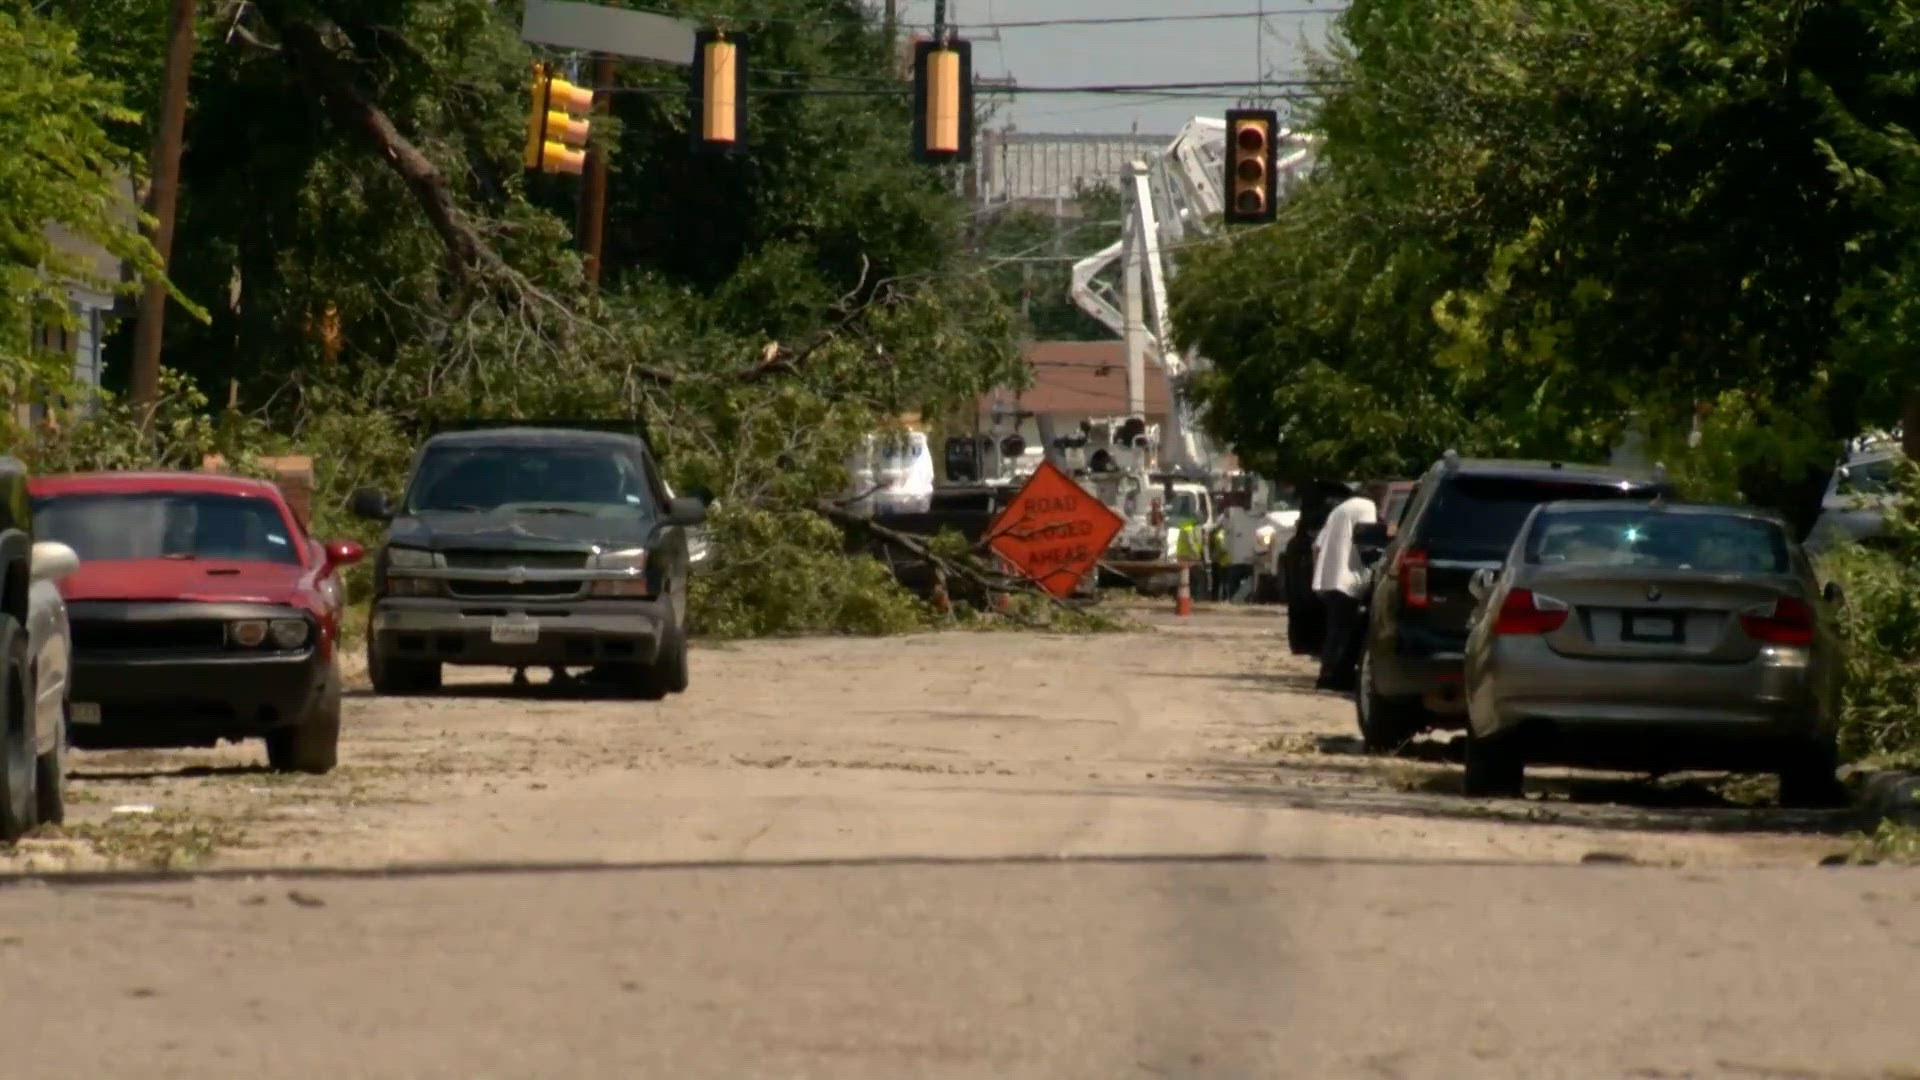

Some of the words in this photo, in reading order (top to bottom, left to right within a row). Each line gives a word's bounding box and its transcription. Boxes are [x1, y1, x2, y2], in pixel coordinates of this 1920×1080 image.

[1024, 496, 1077, 514] ROAD
[1018, 519, 1093, 542] OSED
[1029, 546, 1089, 565] AHEAD
